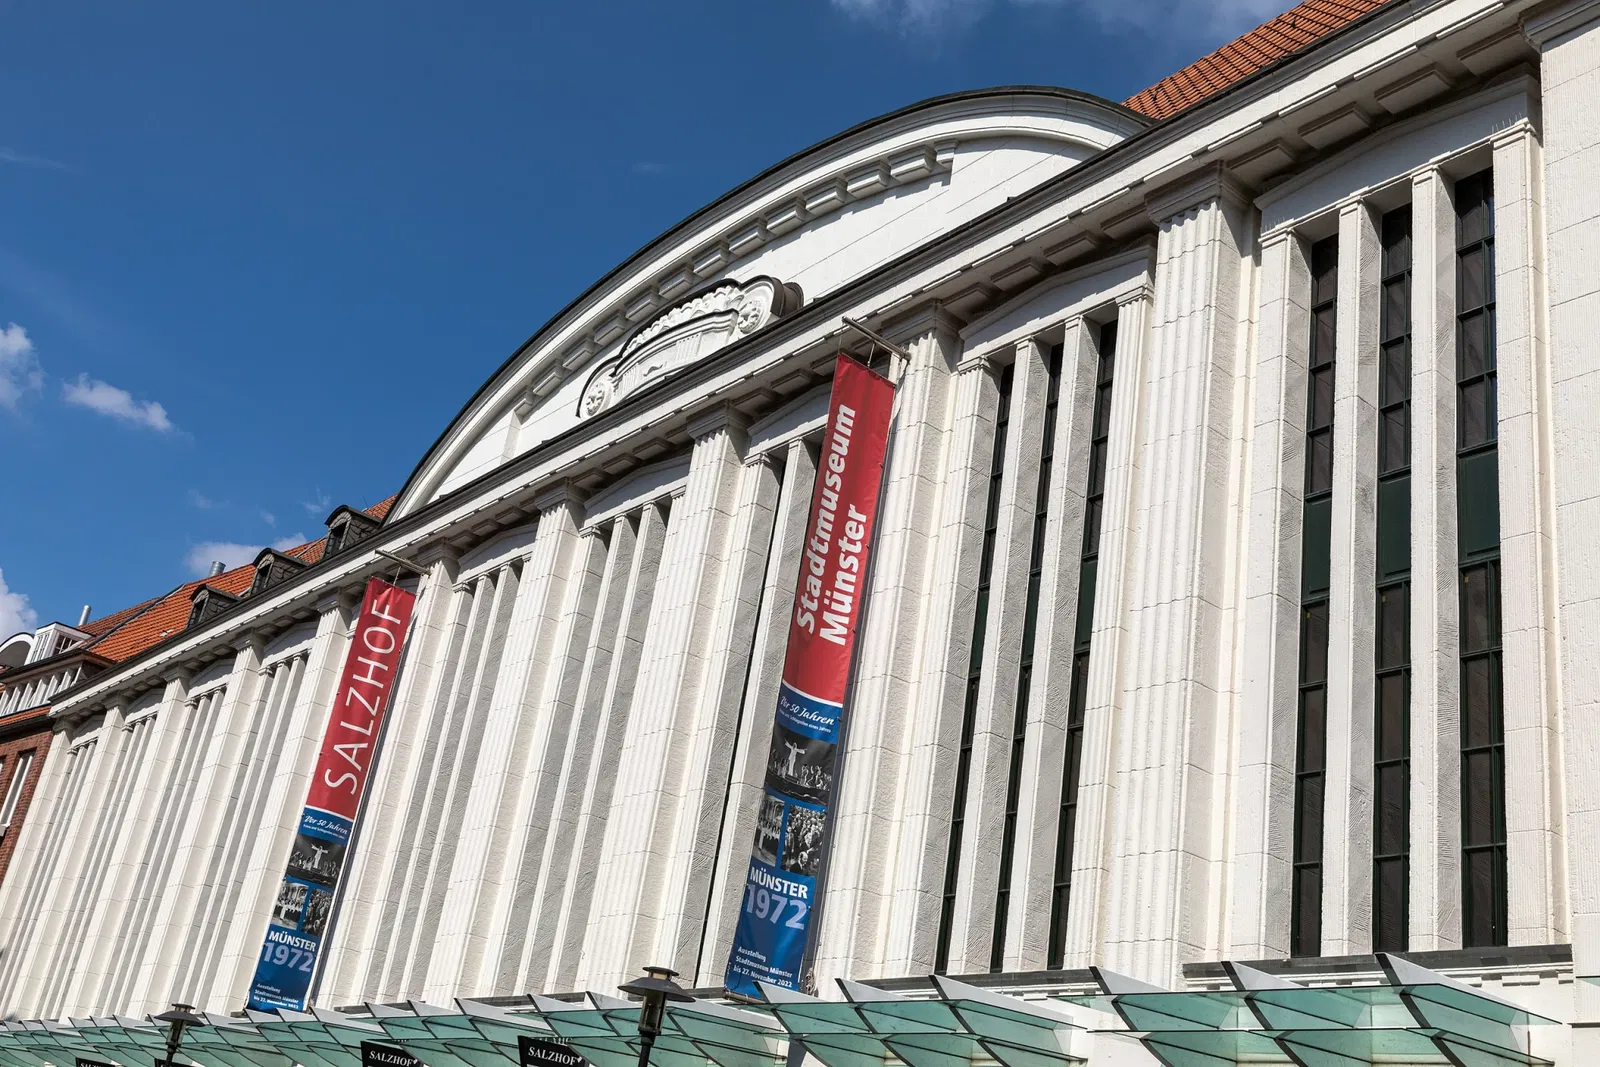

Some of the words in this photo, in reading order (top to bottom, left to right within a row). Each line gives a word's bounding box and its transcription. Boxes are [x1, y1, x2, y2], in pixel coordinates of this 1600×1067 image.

[797, 403, 856, 634] Stadtmuseum
[819, 503, 867, 646] Münster
[324, 599, 401, 795] SALZHOF
[780, 696, 791, 708] Vor
[790, 703, 800, 713] 50
[798, 707, 835, 725] Jahren
[304, 815, 318, 824] Vor
[325, 822, 348, 835] Jahren
[750, 866, 808, 899] MÜNSTER
[746, 883, 807, 930] 1972
[268, 930, 317, 952] MÜNSTER
[737, 946, 767, 962] Ausstellung
[263, 942, 314, 973] 1972
[735, 955, 769, 972] Stadtmuseum
[769, 967, 793, 978] Münster
[733, 964, 741, 973] bis
[750, 970, 776, 984] November
[777, 978, 793, 988] 2022
[369, 1050, 413, 1067] SALZHOF
[528, 1046, 577, 1066] SALZHOF
